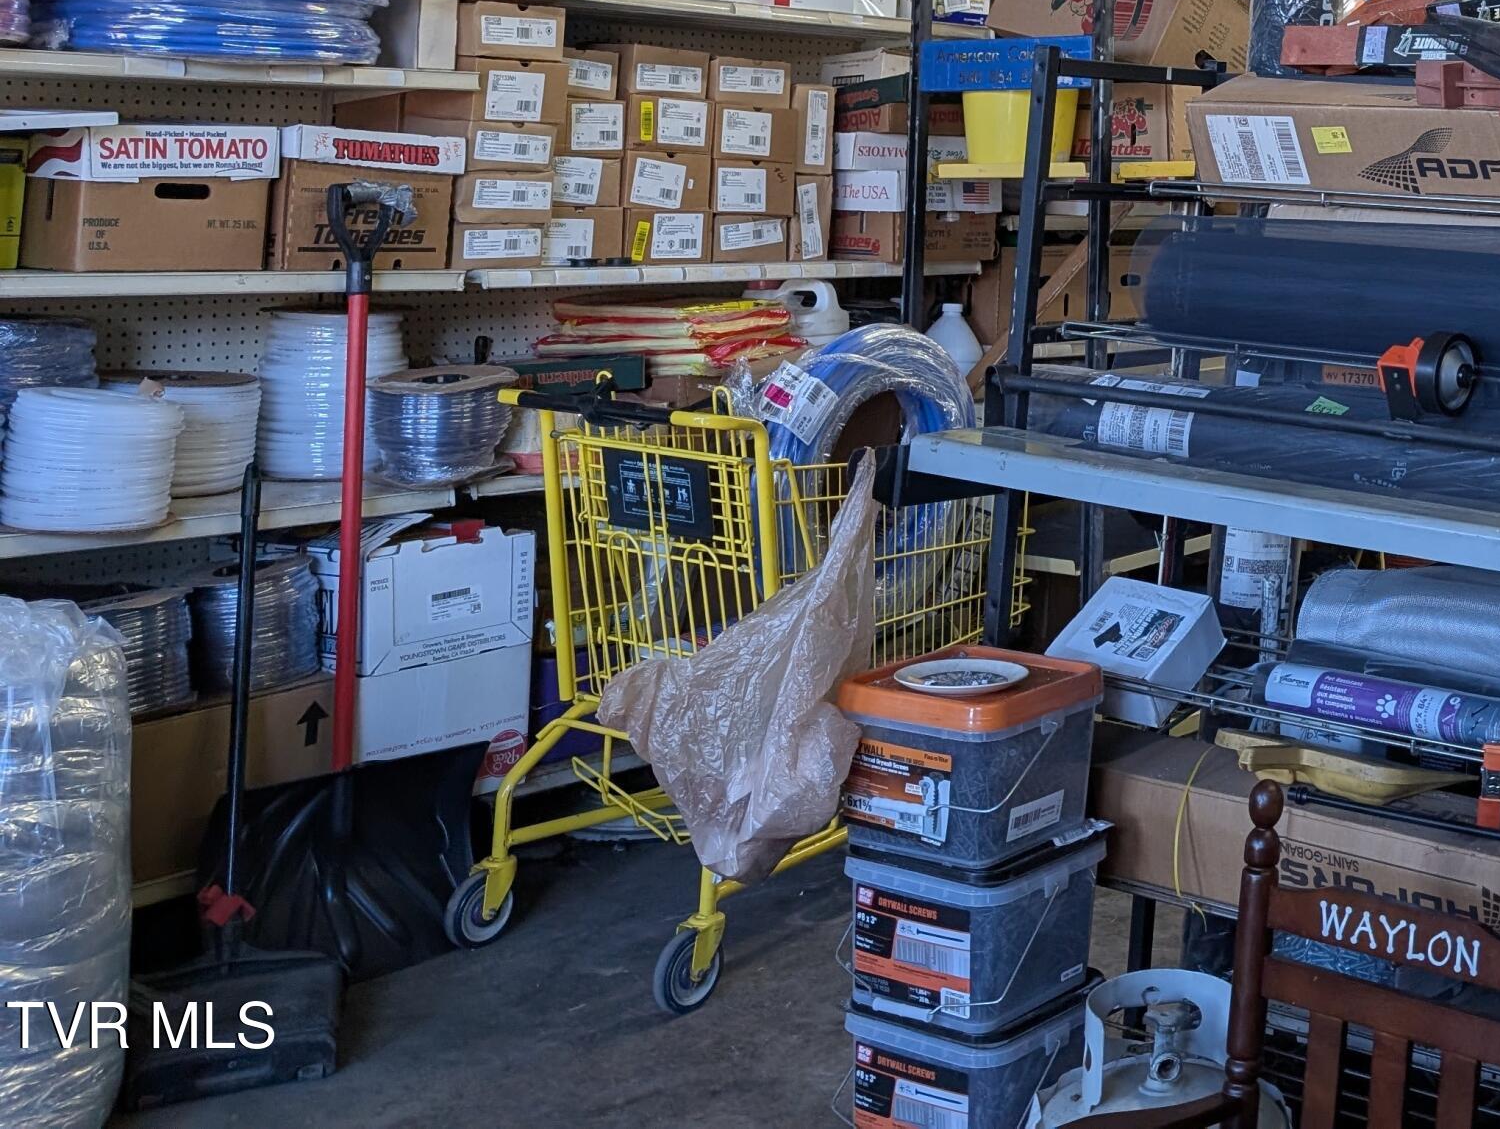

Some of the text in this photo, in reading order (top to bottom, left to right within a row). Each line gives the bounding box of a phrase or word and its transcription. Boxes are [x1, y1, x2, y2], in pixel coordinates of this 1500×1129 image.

[145, 130, 185, 138] Hand-Picked
[189, 130, 206, 138] Hand
[99, 137, 268, 160] SATIN TOMATO
[333, 137, 441, 167] TOMATOES
[857, 145, 909, 159] MATOES
[1074, 138, 1153, 157] Toatoes
[101, 161, 112, 169] We
[113, 162, 125, 170] are
[126, 162, 138, 170] not
[139, 161, 151, 170] the
[151, 161, 179, 171] biggest,
[179, 161, 192, 170] but
[204, 162, 215, 170] are
[843, 184, 890, 200] The USA
[82, 218, 120, 227] PRODUCE
[345, 207, 406, 227] Freh
[95, 230, 106, 240] OF
[313, 223, 426, 245] Tomaoes
[88, 241, 110, 251] U.S.A.
[537, 369, 596, 387] outhern
[1341, 372, 1375, 385] 17370
[370, 578, 389, 587] PRODUCE
[400, 633, 506, 663] YOUNGSTOWN GRAPE DISTRIBUTORS
[1324, 674, 1364, 688] Pet Resistant
[1319, 683, 1348, 695] Résistant
[1316, 691, 1354, 704] aux animaux
[1316, 697, 1356, 712] de compagnie
[490, 748, 519, 767] Rice
[858, 744, 886, 758] YWALL
[878, 896, 938, 921] DRYWALL SCREWS
[1319, 898, 1482, 978] WAYLON
[877, 1055, 937, 1081] DRYWALL SCREWS
